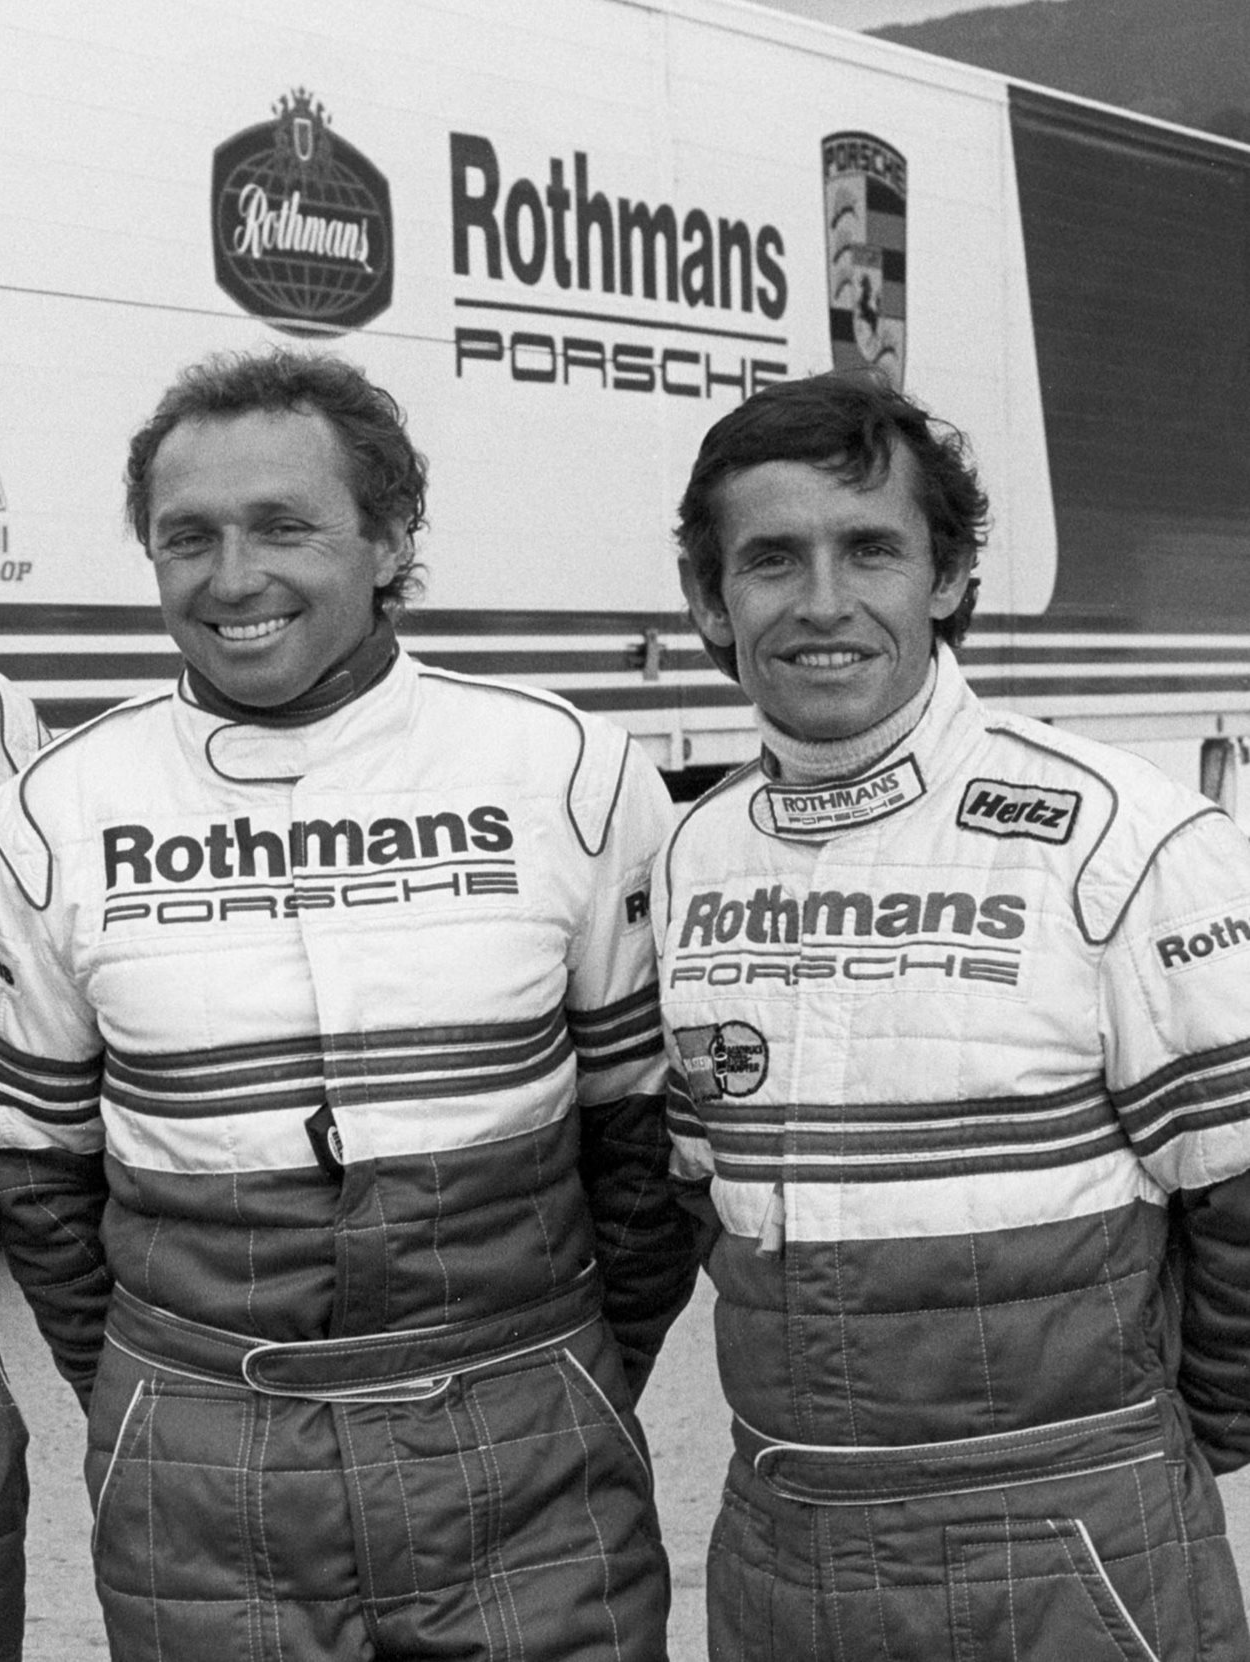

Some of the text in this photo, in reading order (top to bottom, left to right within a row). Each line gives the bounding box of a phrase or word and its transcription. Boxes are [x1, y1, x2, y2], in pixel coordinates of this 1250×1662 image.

[822, 142, 906, 194] PORSCHE
[234, 183, 375, 273] Rothmans
[449, 130, 788, 321] Rothmans
[454, 326, 788, 400] PORSCHE
[781, 771, 900, 813] ROTHMANS
[788, 792, 906, 825] PORSCHE
[965, 790, 1070, 829] Hertz
[103, 804, 514, 890] Rothmans
[102, 870, 519, 932] PORSCHE
[677, 883, 1027, 949] Rothmans
[669, 951, 1020, 989] PORSCHE
[1155, 916, 1250, 969] Roth
